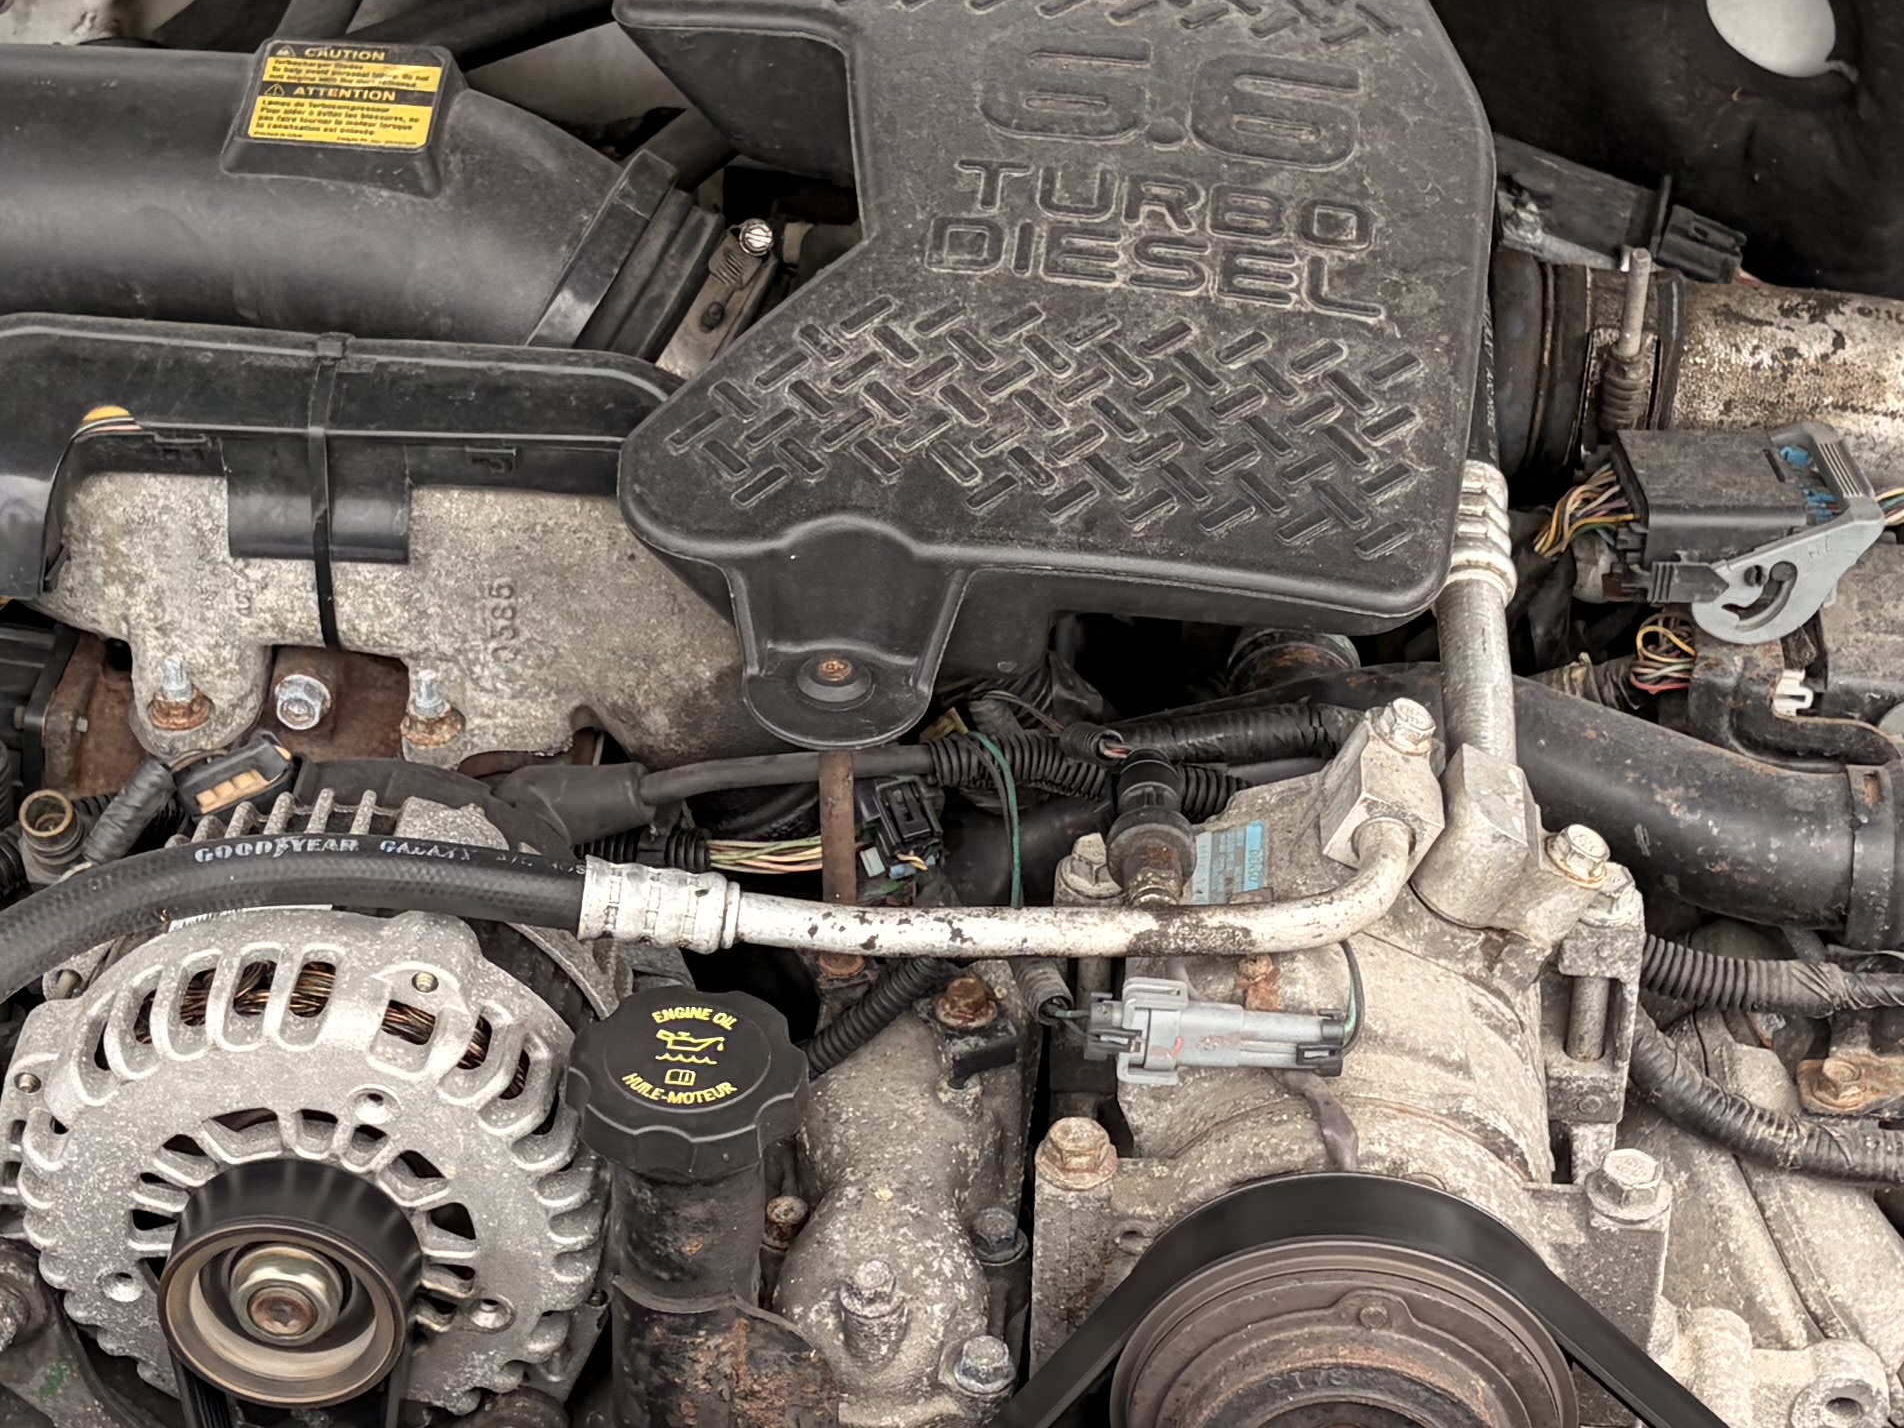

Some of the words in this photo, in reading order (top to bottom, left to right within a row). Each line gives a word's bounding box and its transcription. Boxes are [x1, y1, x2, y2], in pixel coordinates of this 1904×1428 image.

[303, 48, 385, 61] CAUTION
[292, 86, 396, 101] ATTENTION
[980, 33, 1363, 168] 6.6
[956, 158, 1373, 255] TURBO
[925, 217, 1386, 322] DIESEL
[194, 836, 359, 863] GOODYEAR
[652, 1007, 714, 1024] ENGINE
[712, 1012, 738, 1030] OIL
[621, 1072, 738, 1105] HUILE-MOTEUR
